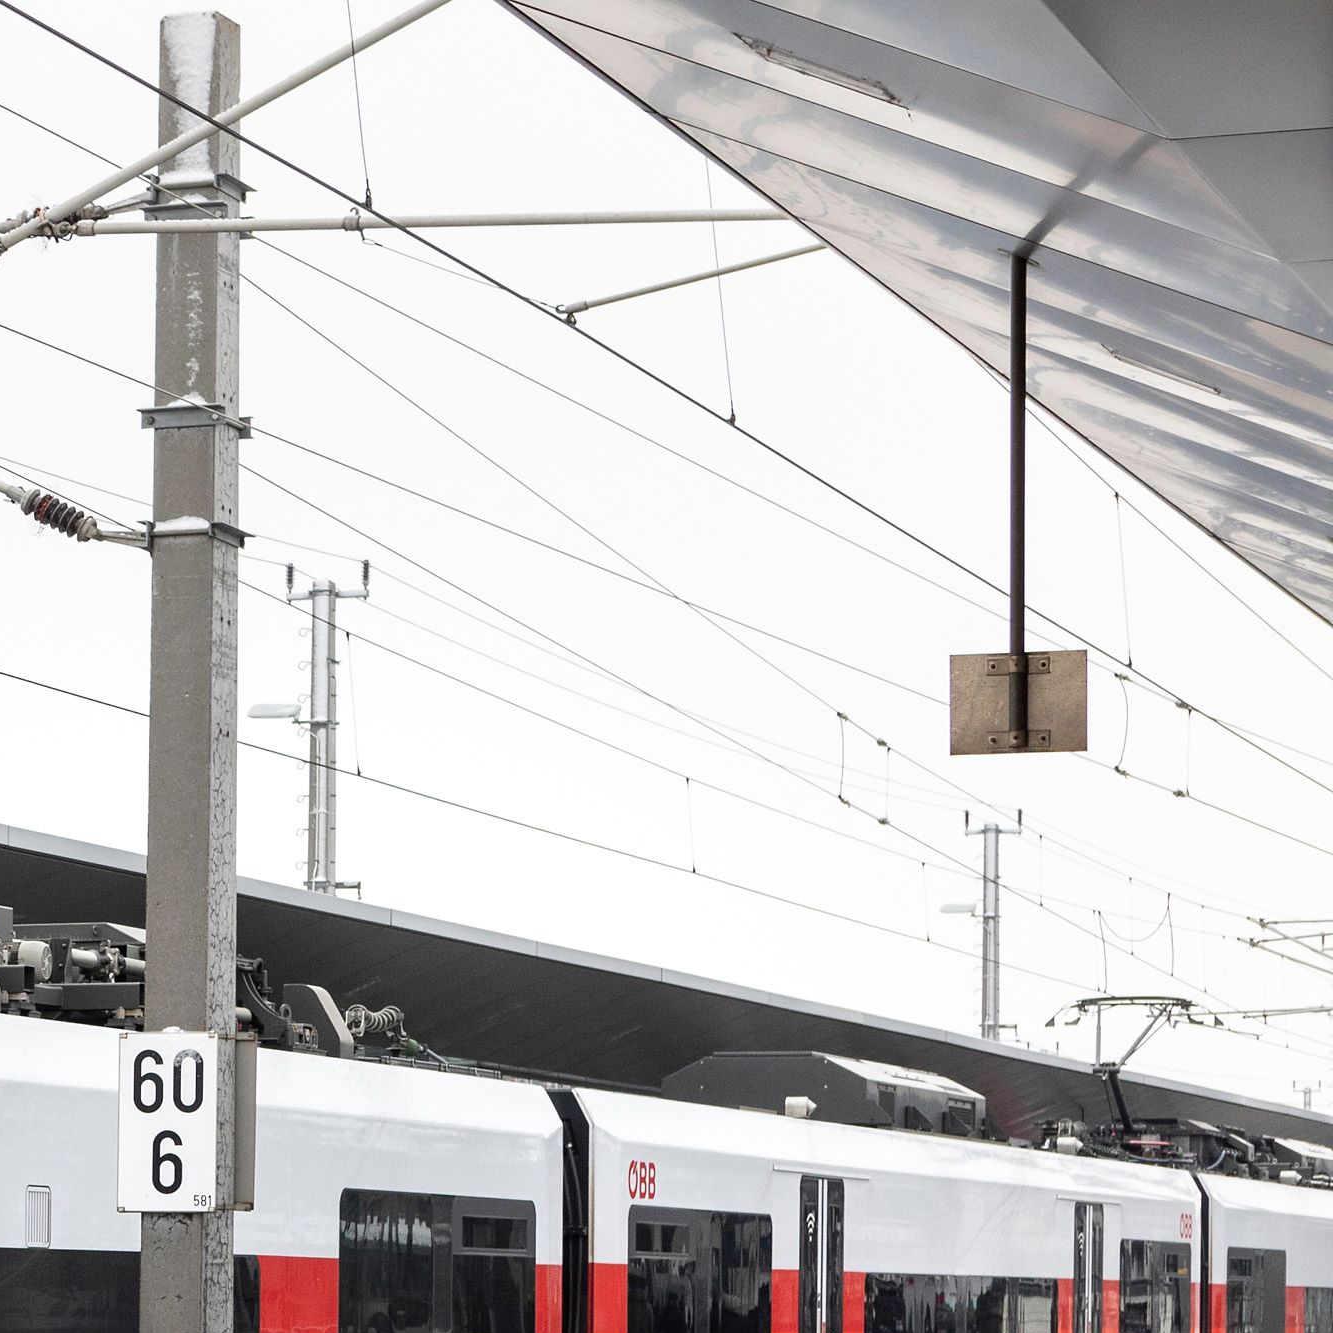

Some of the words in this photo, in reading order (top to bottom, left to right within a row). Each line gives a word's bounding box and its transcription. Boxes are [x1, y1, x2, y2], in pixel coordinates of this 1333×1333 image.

[133, 1049, 204, 1114] 60
[152, 1130, 183, 1195] 6
[628, 1159, 656, 1200] ÖBB
[193, 1194, 212, 1207] 581
